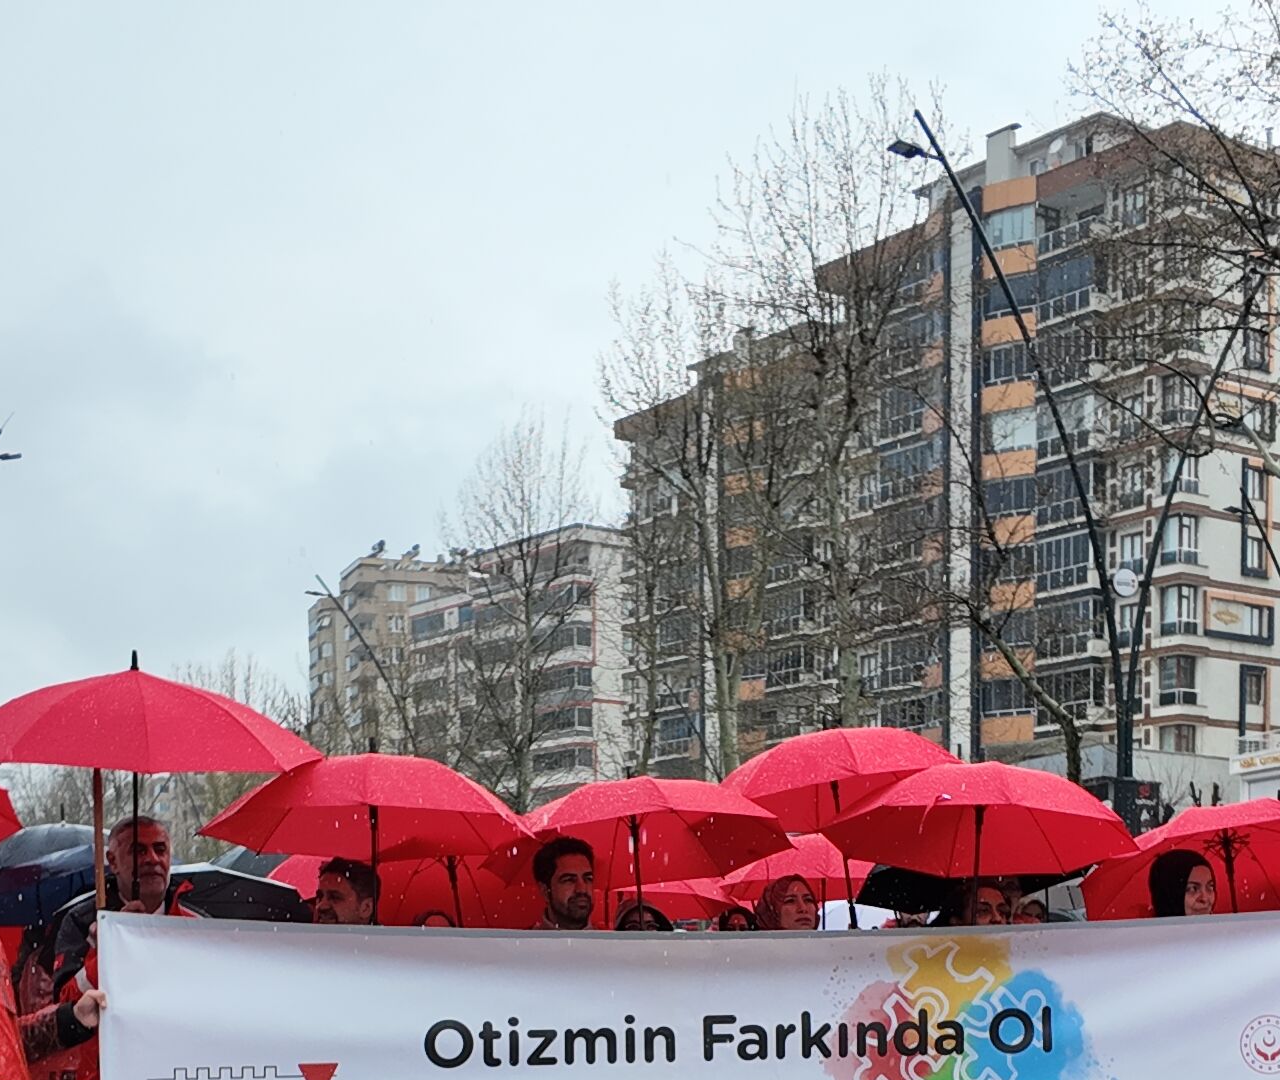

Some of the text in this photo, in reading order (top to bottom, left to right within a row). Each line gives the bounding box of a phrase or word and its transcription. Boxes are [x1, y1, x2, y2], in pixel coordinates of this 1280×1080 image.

[424, 1005, 1053, 1069] Otizmin Farkında Ol
